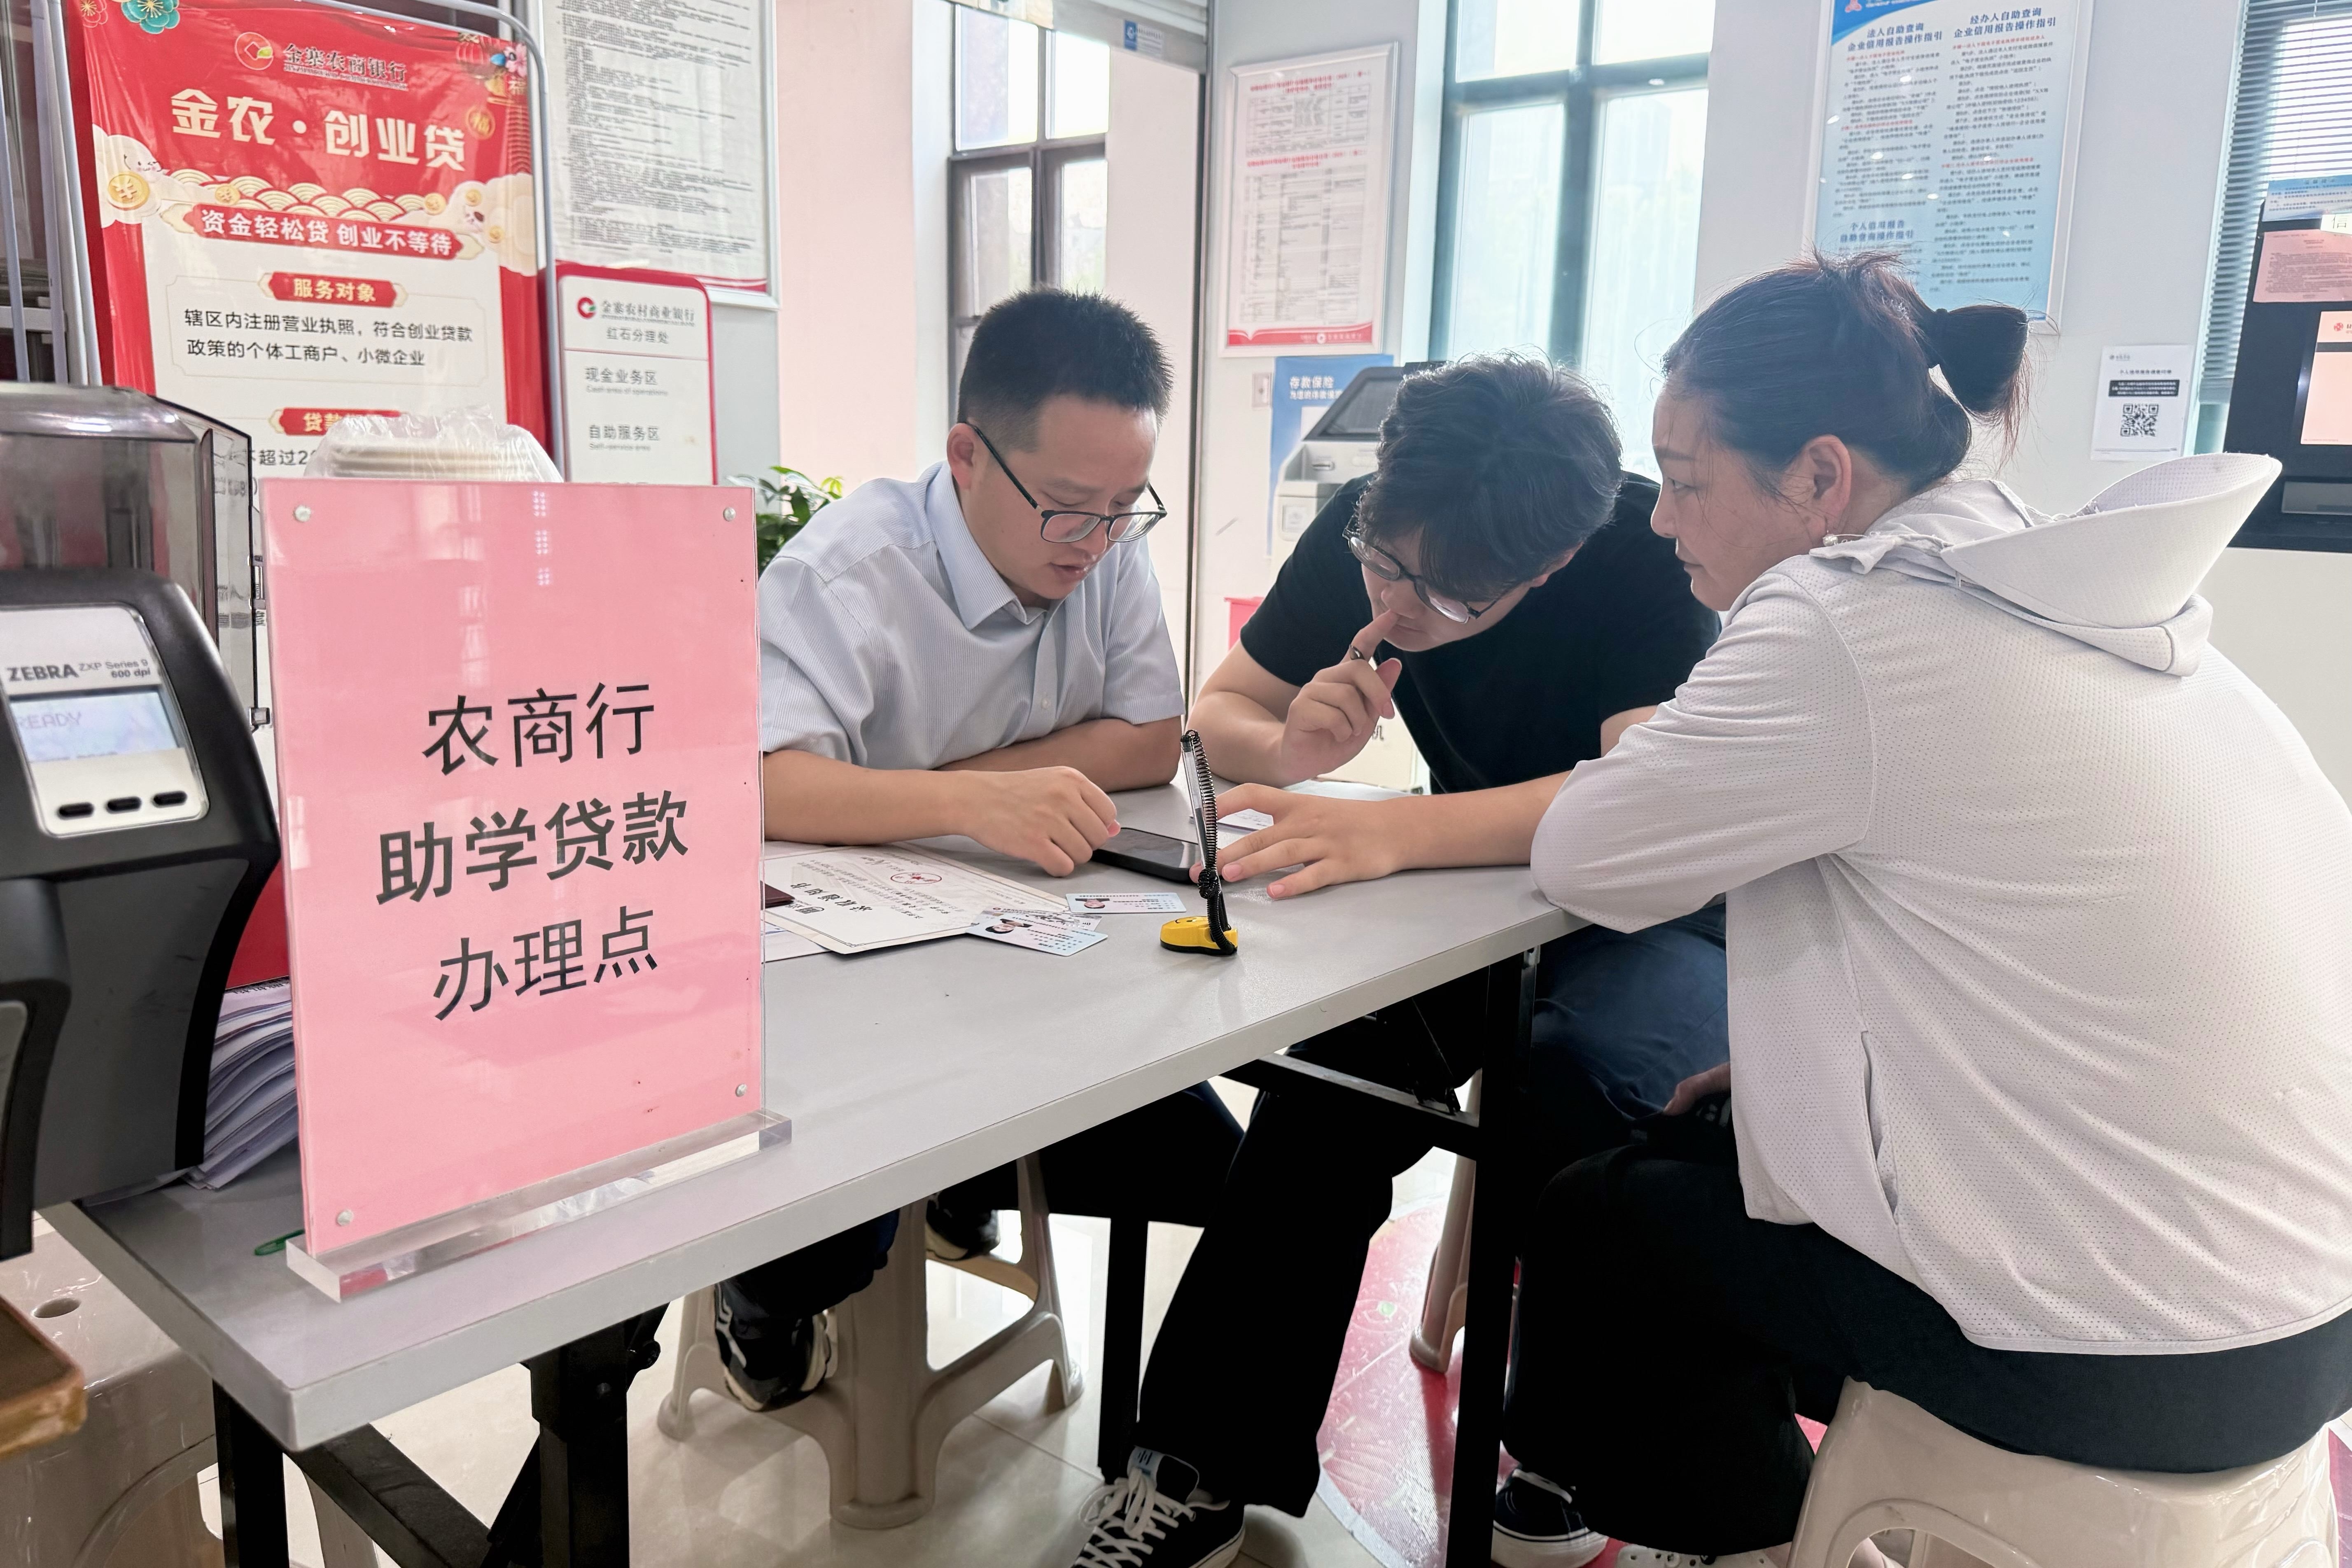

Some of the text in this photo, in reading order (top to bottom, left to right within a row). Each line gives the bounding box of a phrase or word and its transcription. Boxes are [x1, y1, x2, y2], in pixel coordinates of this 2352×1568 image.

[1970, 7, 2042, 25] 经办人自助查询
[1953, 17, 2056, 38] 企业信用报告操作指引
[283, 43, 407, 82] 金寨农商银行
[2331, 214, 2347, 229] 信
[202, 209, 452, 256] 资金轻松贷 创业不等待
[294, 278, 376, 302] 服务对象
[607, 327, 669, 344] 红石分理处
[585, 367, 658, 385] 现金业务区
[589, 424, 660, 441] 自助服务区
[7, 664, 79, 682] ZEBRA
[79, 662, 102, 672] ZXP
[105, 660, 140, 669] Series
[111, 667, 151, 678] 600 dpi
[422, 682, 655, 776] 农商行
[376, 790, 688, 905] 助学贷款
[433, 905, 658, 1021] 办理点
